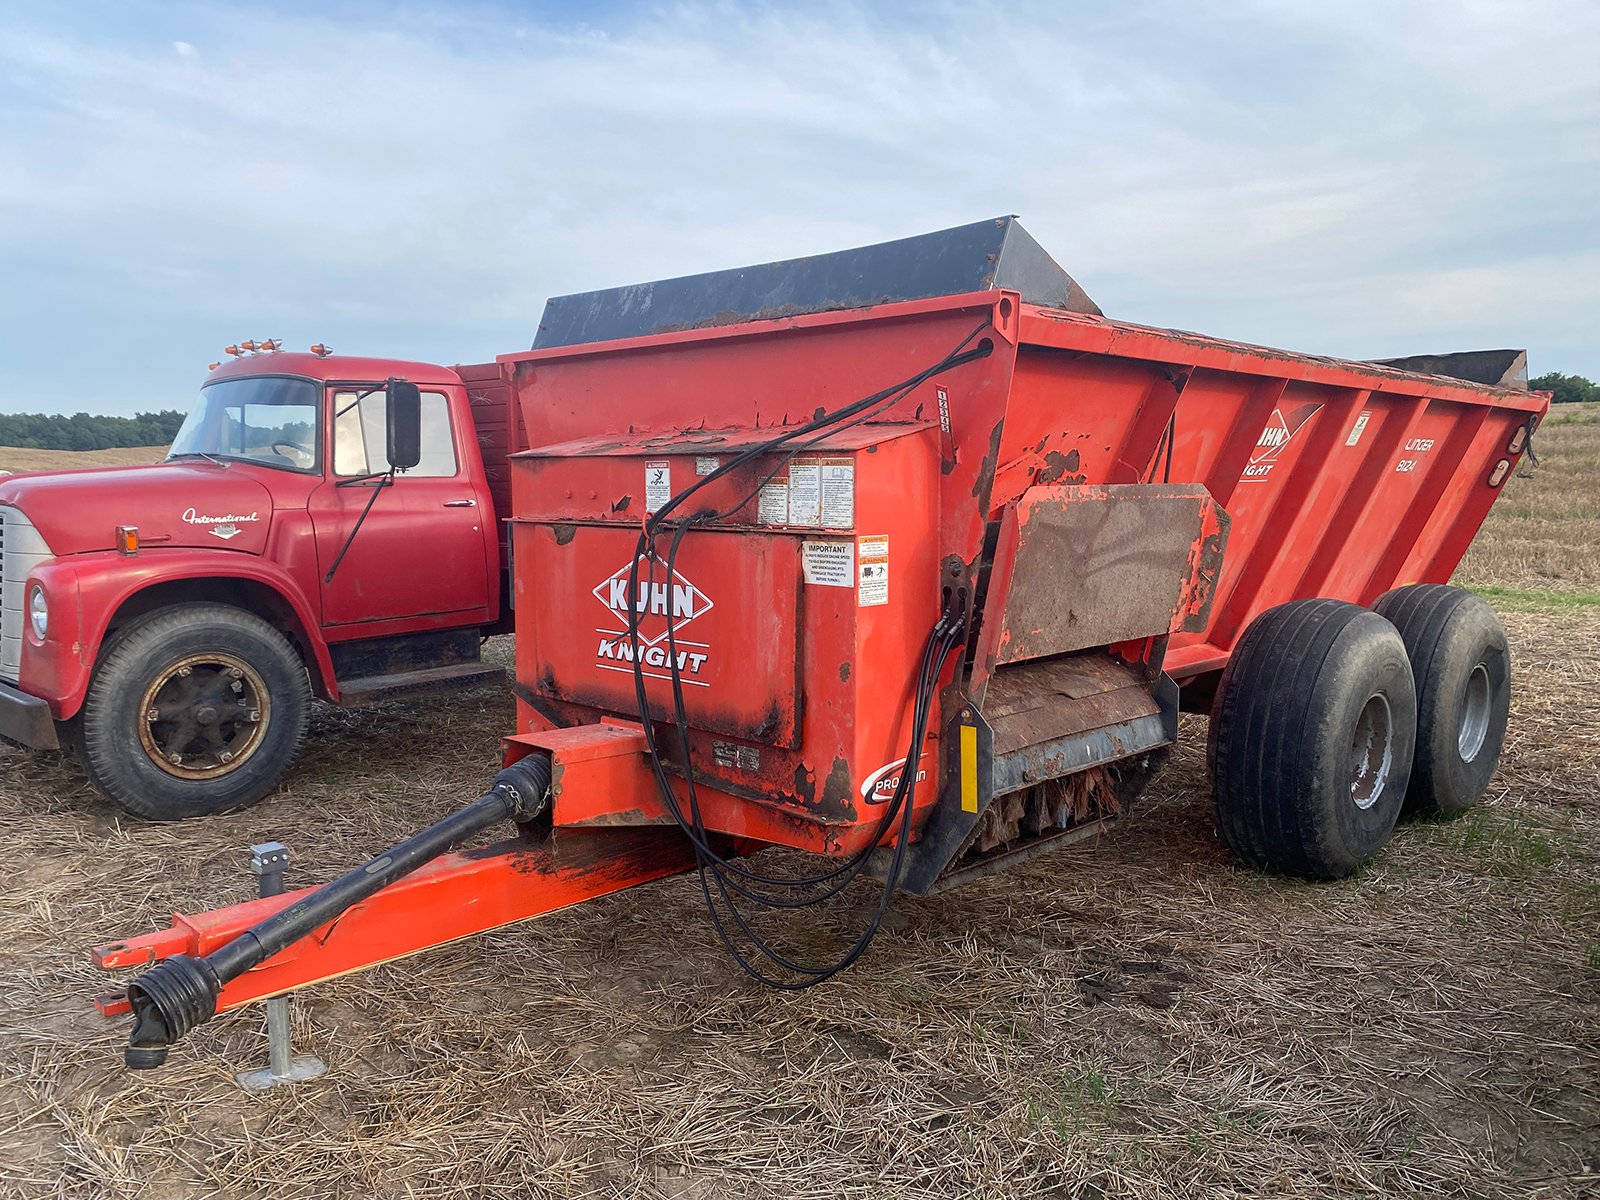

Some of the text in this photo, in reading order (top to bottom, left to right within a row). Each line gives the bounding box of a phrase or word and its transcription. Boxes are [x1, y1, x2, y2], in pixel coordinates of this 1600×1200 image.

[1241, 464, 1274, 476] IGHT
[1395, 459, 1418, 472] 8124
[182, 507, 260, 524] International
[809, 545, 846, 553] IMPORTANT
[597, 639, 708, 673] KNIGHT
